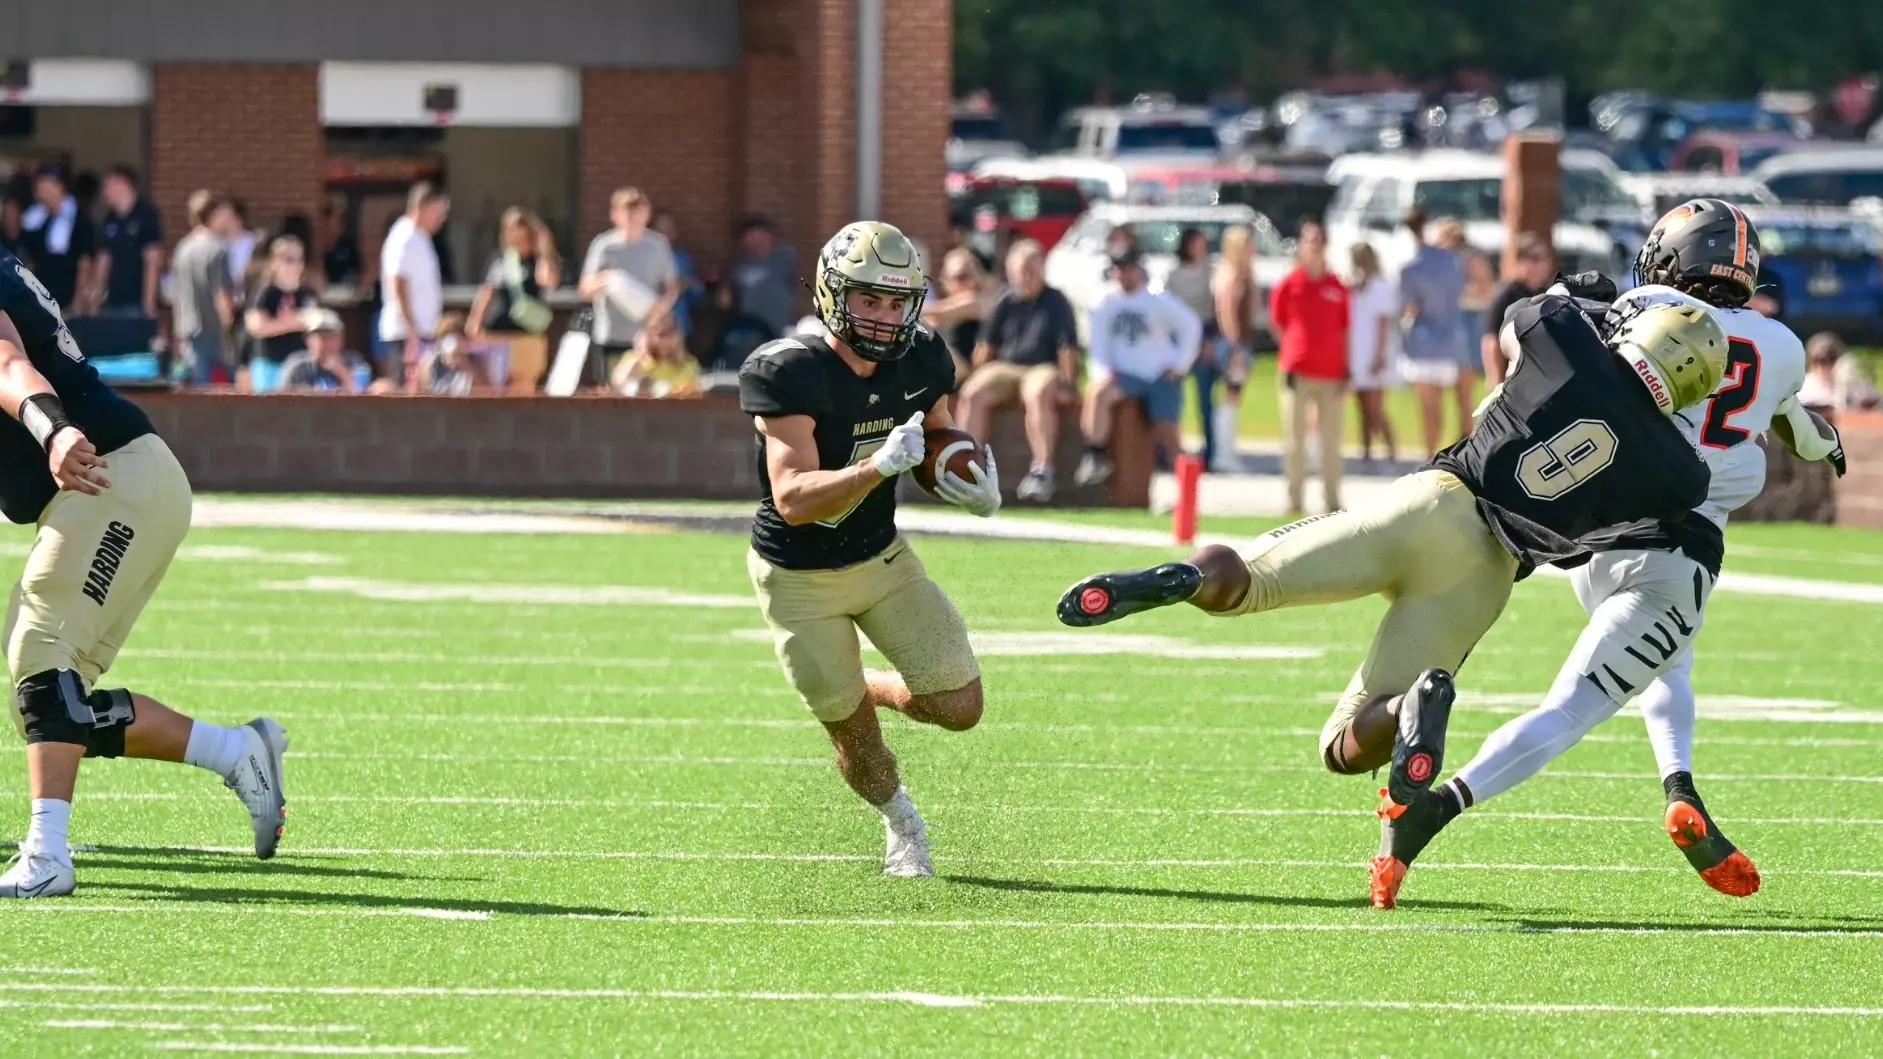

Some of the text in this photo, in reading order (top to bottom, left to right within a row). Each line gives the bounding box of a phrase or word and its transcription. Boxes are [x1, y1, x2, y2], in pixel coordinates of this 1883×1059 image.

[881, 275, 908, 285] Riddell
[1710, 264, 1734, 278] EAST
[1634, 358, 1671, 408] Riddell
[1700, 335, 1762, 450] 2
[852, 417, 895, 437] HARDING
[1514, 418, 1620, 501] 9
[82, 520, 135, 608] HARDING
